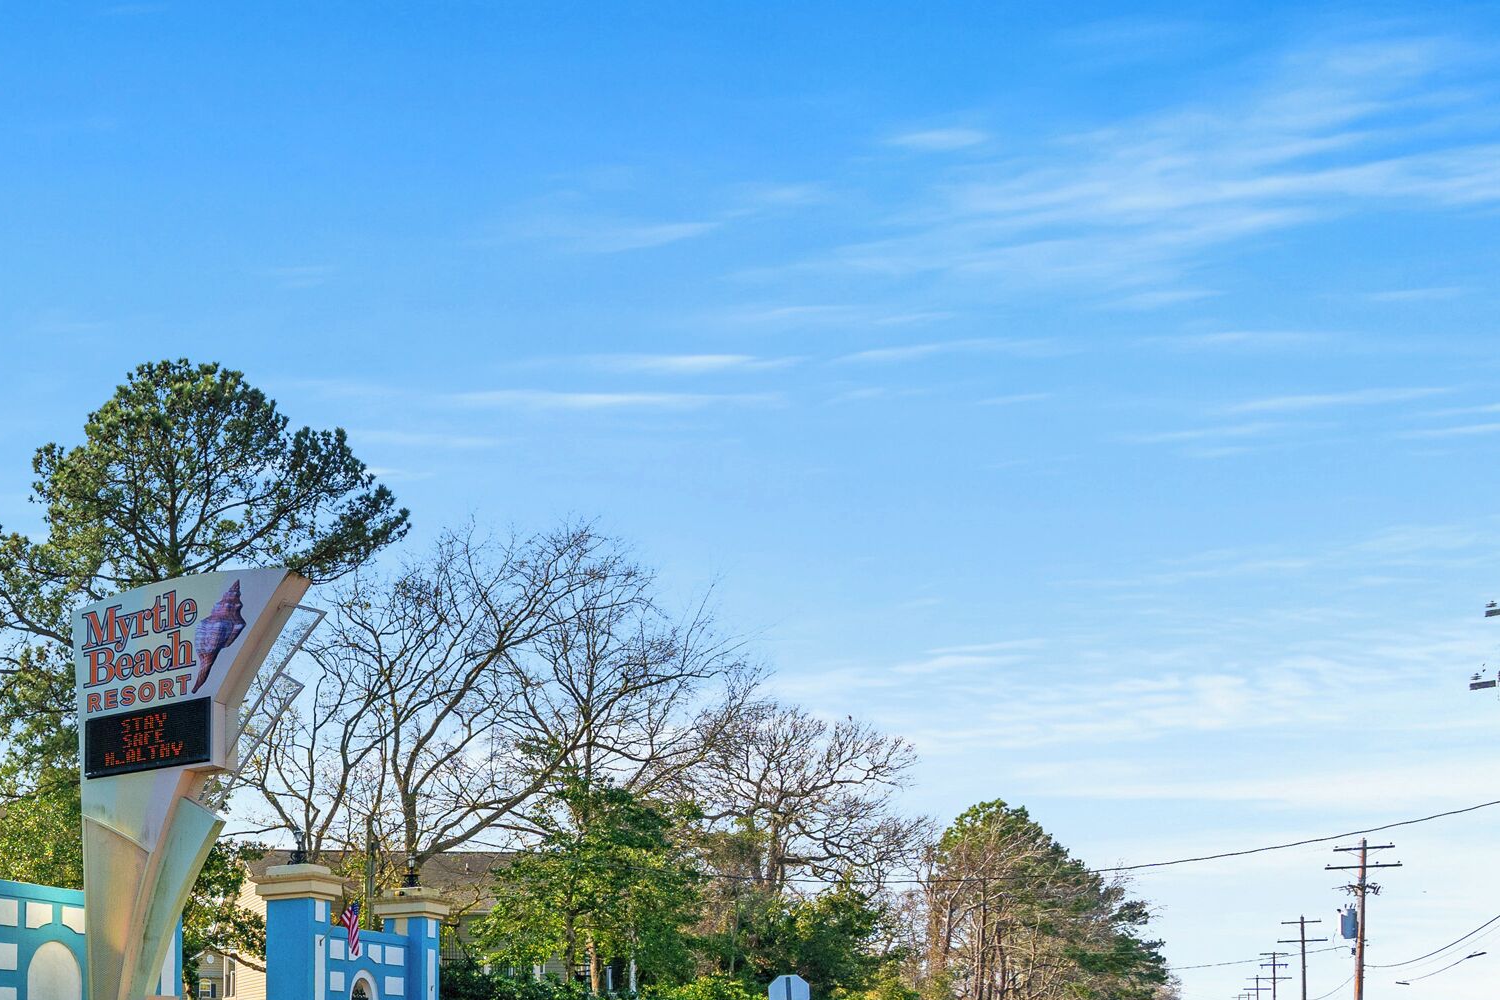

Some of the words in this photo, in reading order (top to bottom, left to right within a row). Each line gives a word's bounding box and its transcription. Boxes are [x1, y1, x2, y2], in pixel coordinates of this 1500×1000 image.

[82, 590, 197, 652] Myrtle
[83, 630, 196, 688] Beach
[87, 674, 191, 713] RESORT
[121, 712, 168, 733] STAY
[121, 728, 165, 749] SAFE
